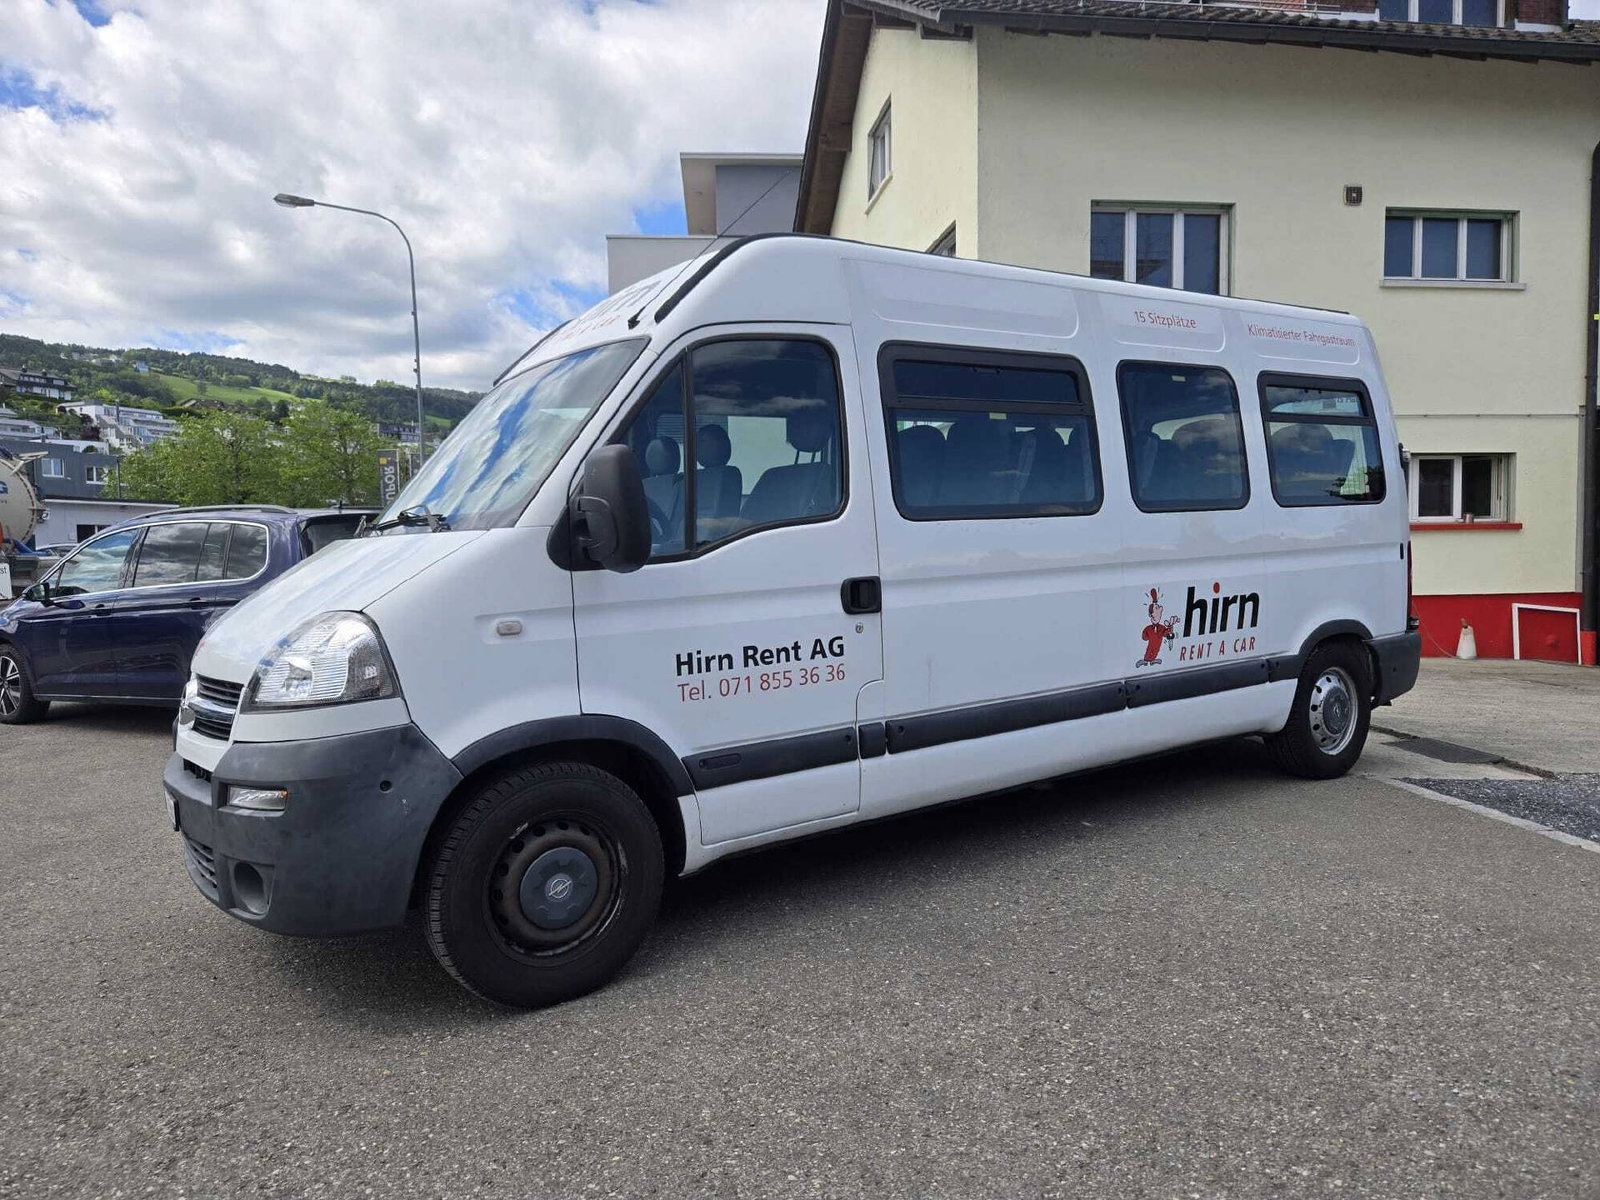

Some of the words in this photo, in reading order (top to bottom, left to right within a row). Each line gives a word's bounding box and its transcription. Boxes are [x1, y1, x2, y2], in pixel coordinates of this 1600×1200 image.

[1134, 310, 1146, 323] 15
[1147, 311, 1197, 329] Sitzplätze
[1247, 322, 1302, 341] Klimatisierter
[1302, 330, 1356, 347] Fahrgastraum
[1182, 581, 1260, 638] hirn
[675, 650, 734, 676] Hirn
[742, 640, 802, 668] Rent
[809, 635, 845, 660] AG
[1179, 642, 1212, 661] RENT
[1218, 640, 1225, 656] A
[1233, 636, 1256, 653] CAR
[677, 680, 712, 702] Tel.
[719, 675, 751, 697] 071
[759, 670, 793, 691] 855
[799, 666, 820, 686] 36
[825, 663, 846, 682] 36
